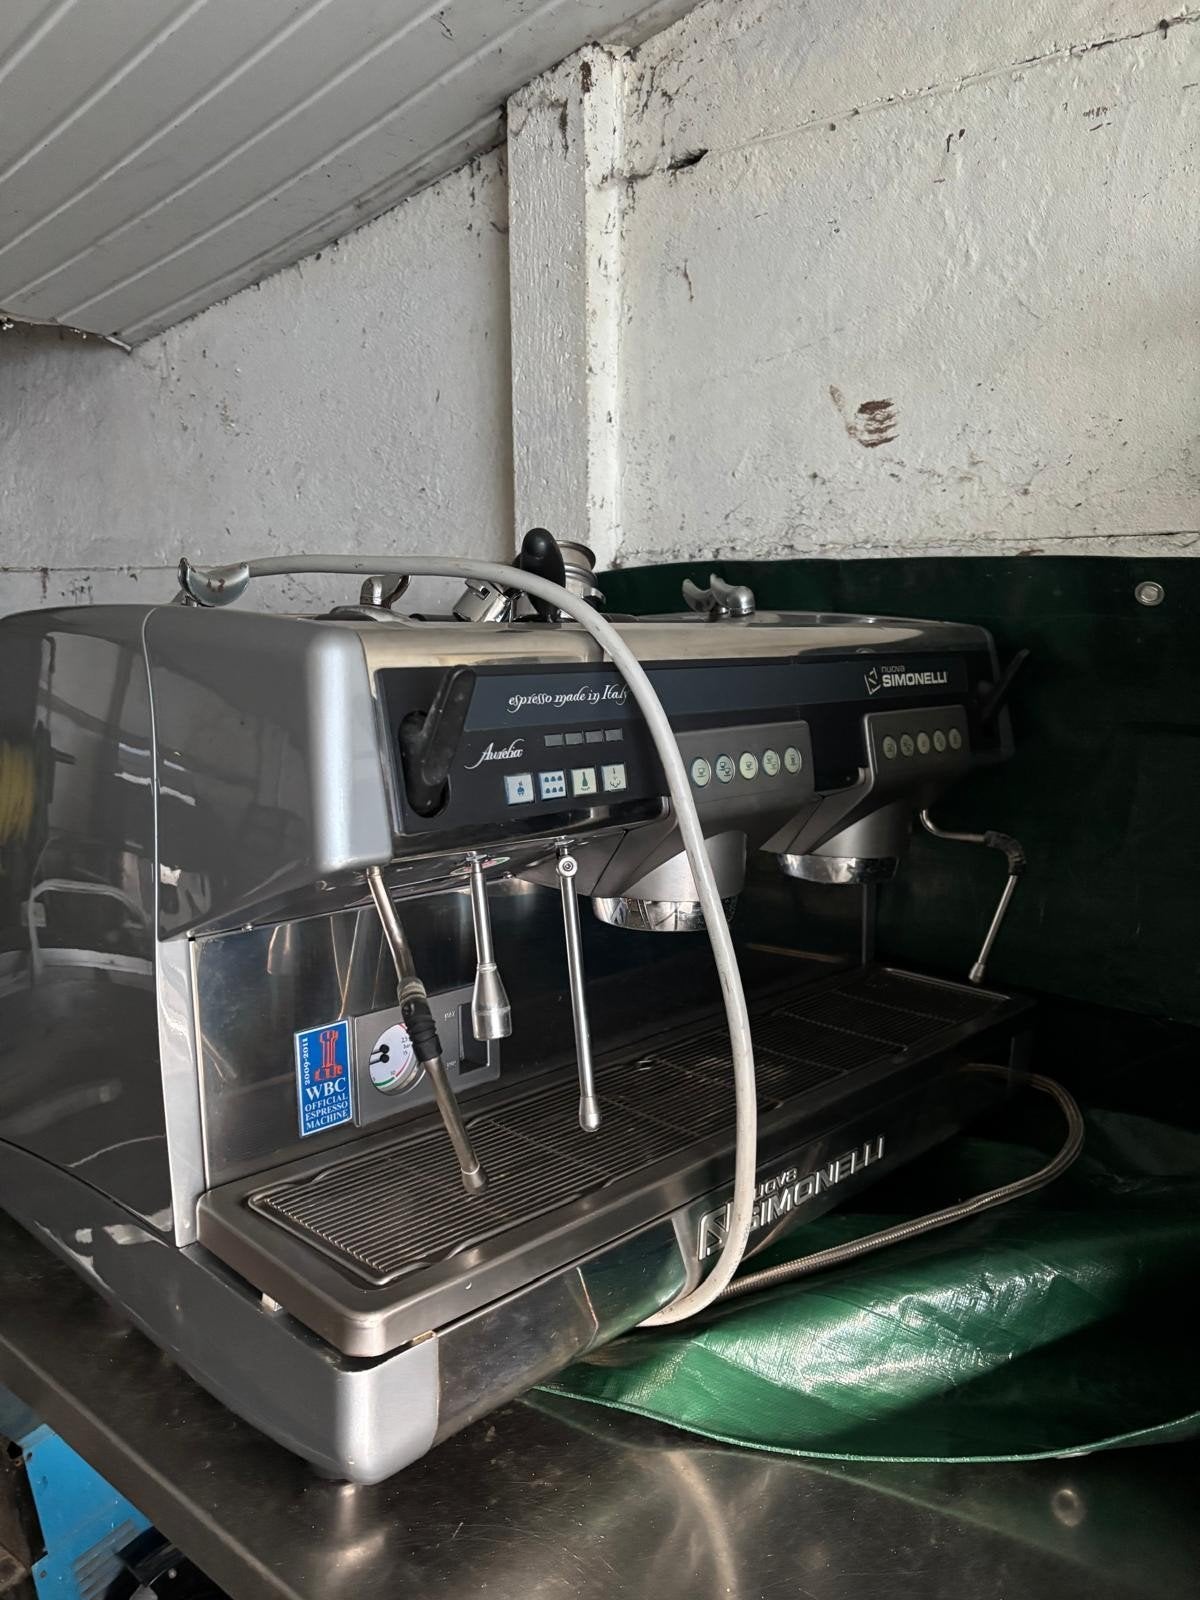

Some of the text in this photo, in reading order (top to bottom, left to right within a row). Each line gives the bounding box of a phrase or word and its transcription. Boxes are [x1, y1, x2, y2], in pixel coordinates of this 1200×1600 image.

[881, 665, 906, 673] nuova
[882, 671, 948, 688] SIMONELLI
[507, 684, 628, 714] espresso made in Italy
[464, 738, 525, 769] Aurelia
[302, 1037, 311, 1086] 2009-2011
[306, 1076, 346, 1101] WBC
[304, 1092, 348, 1113] OFFICIAL
[305, 1100, 348, 1122] ESPRESSO
[306, 1109, 348, 1131] MACHINE
[754, 1167, 798, 1201] uova
